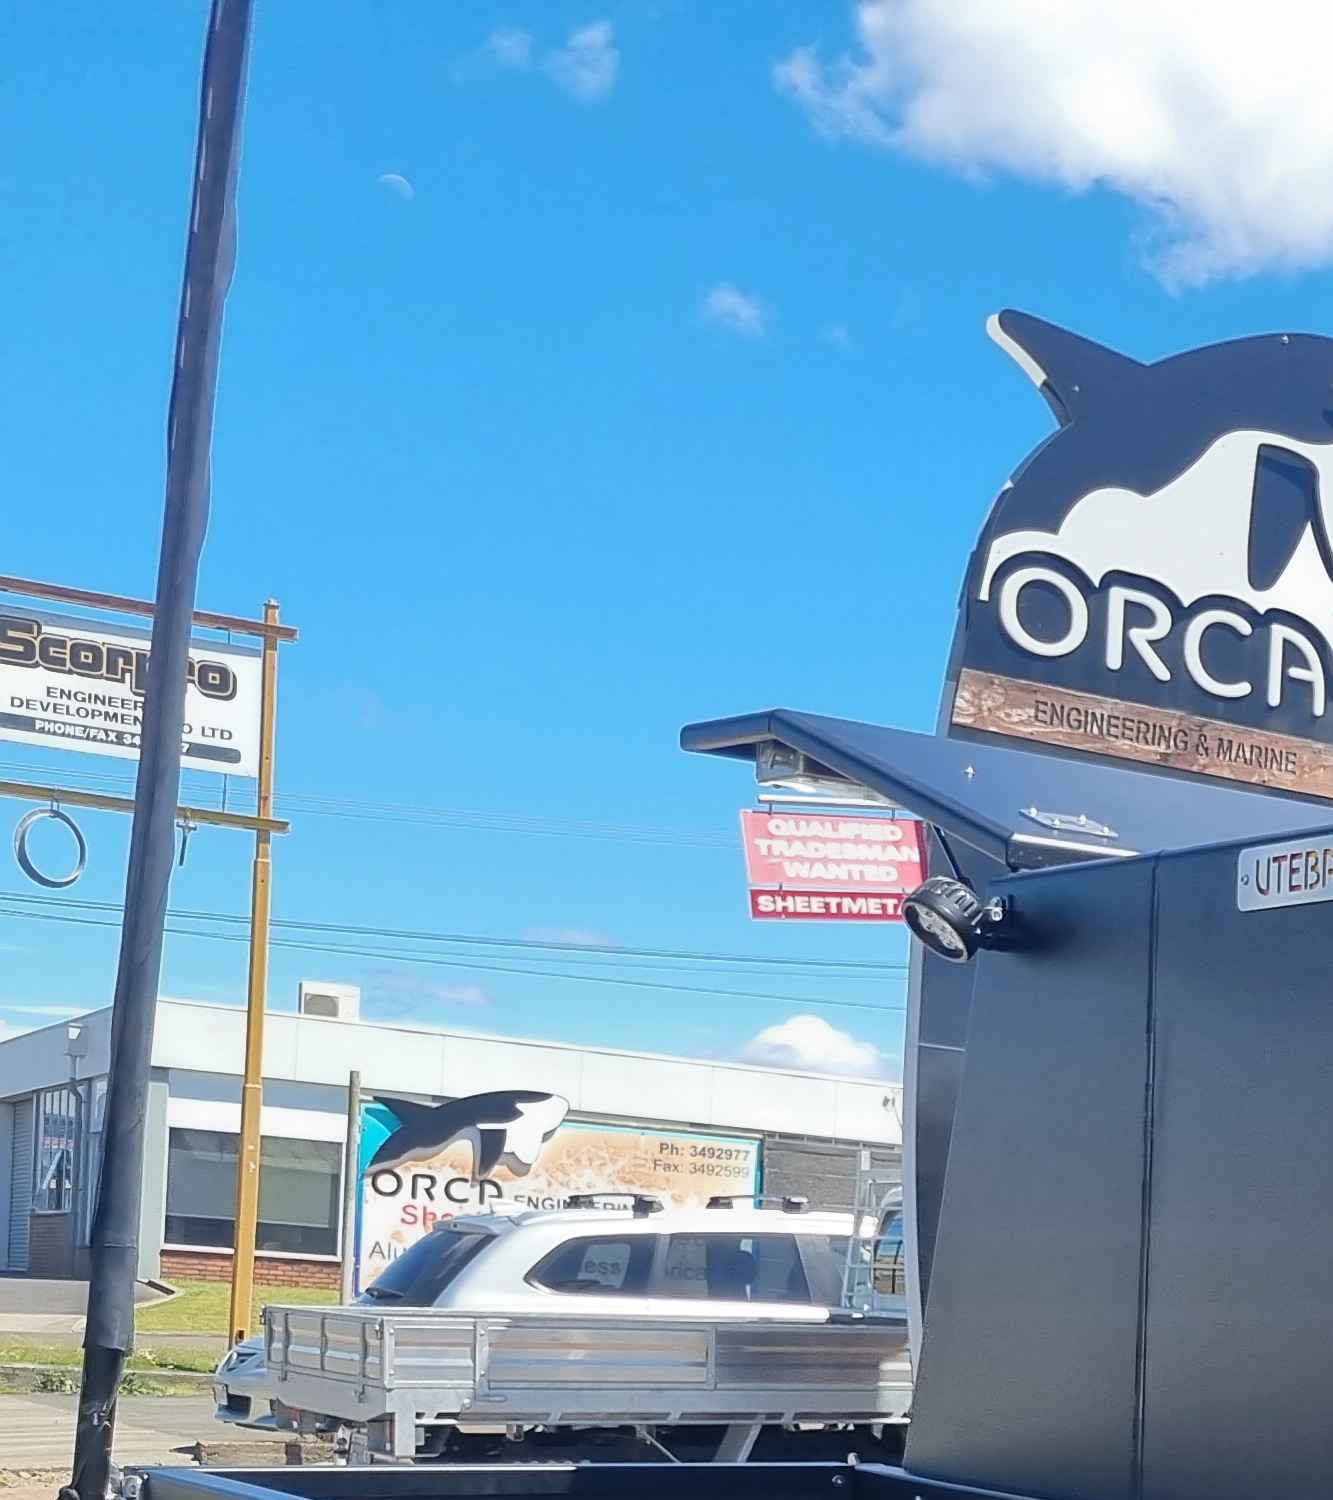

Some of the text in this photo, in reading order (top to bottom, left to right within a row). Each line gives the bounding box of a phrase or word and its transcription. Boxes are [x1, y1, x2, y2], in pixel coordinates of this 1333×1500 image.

[1000, 567, 1326, 717] ORCA
[0, 615, 238, 701] Scoro
[46, 685, 145, 712] ENGINEER
[10, 696, 143, 727] DEVELOPMEN
[201, 726, 233, 741] LTD
[35, 719, 118, 742] PHONE/FAX
[1034, 699, 1298, 775] ENGINEERING & MARINE
[768, 818, 903, 842] QUALIFIED
[753, 838, 921, 863] TRADESMAN
[783, 861, 899, 882] WANTED
[757, 895, 903, 916] SHEETMET
[660, 1142, 751, 1162] Ph: 3492977
[653, 1158, 750, 1179] Fax: 3492599
[371, 1169, 504, 1206] ORCA
